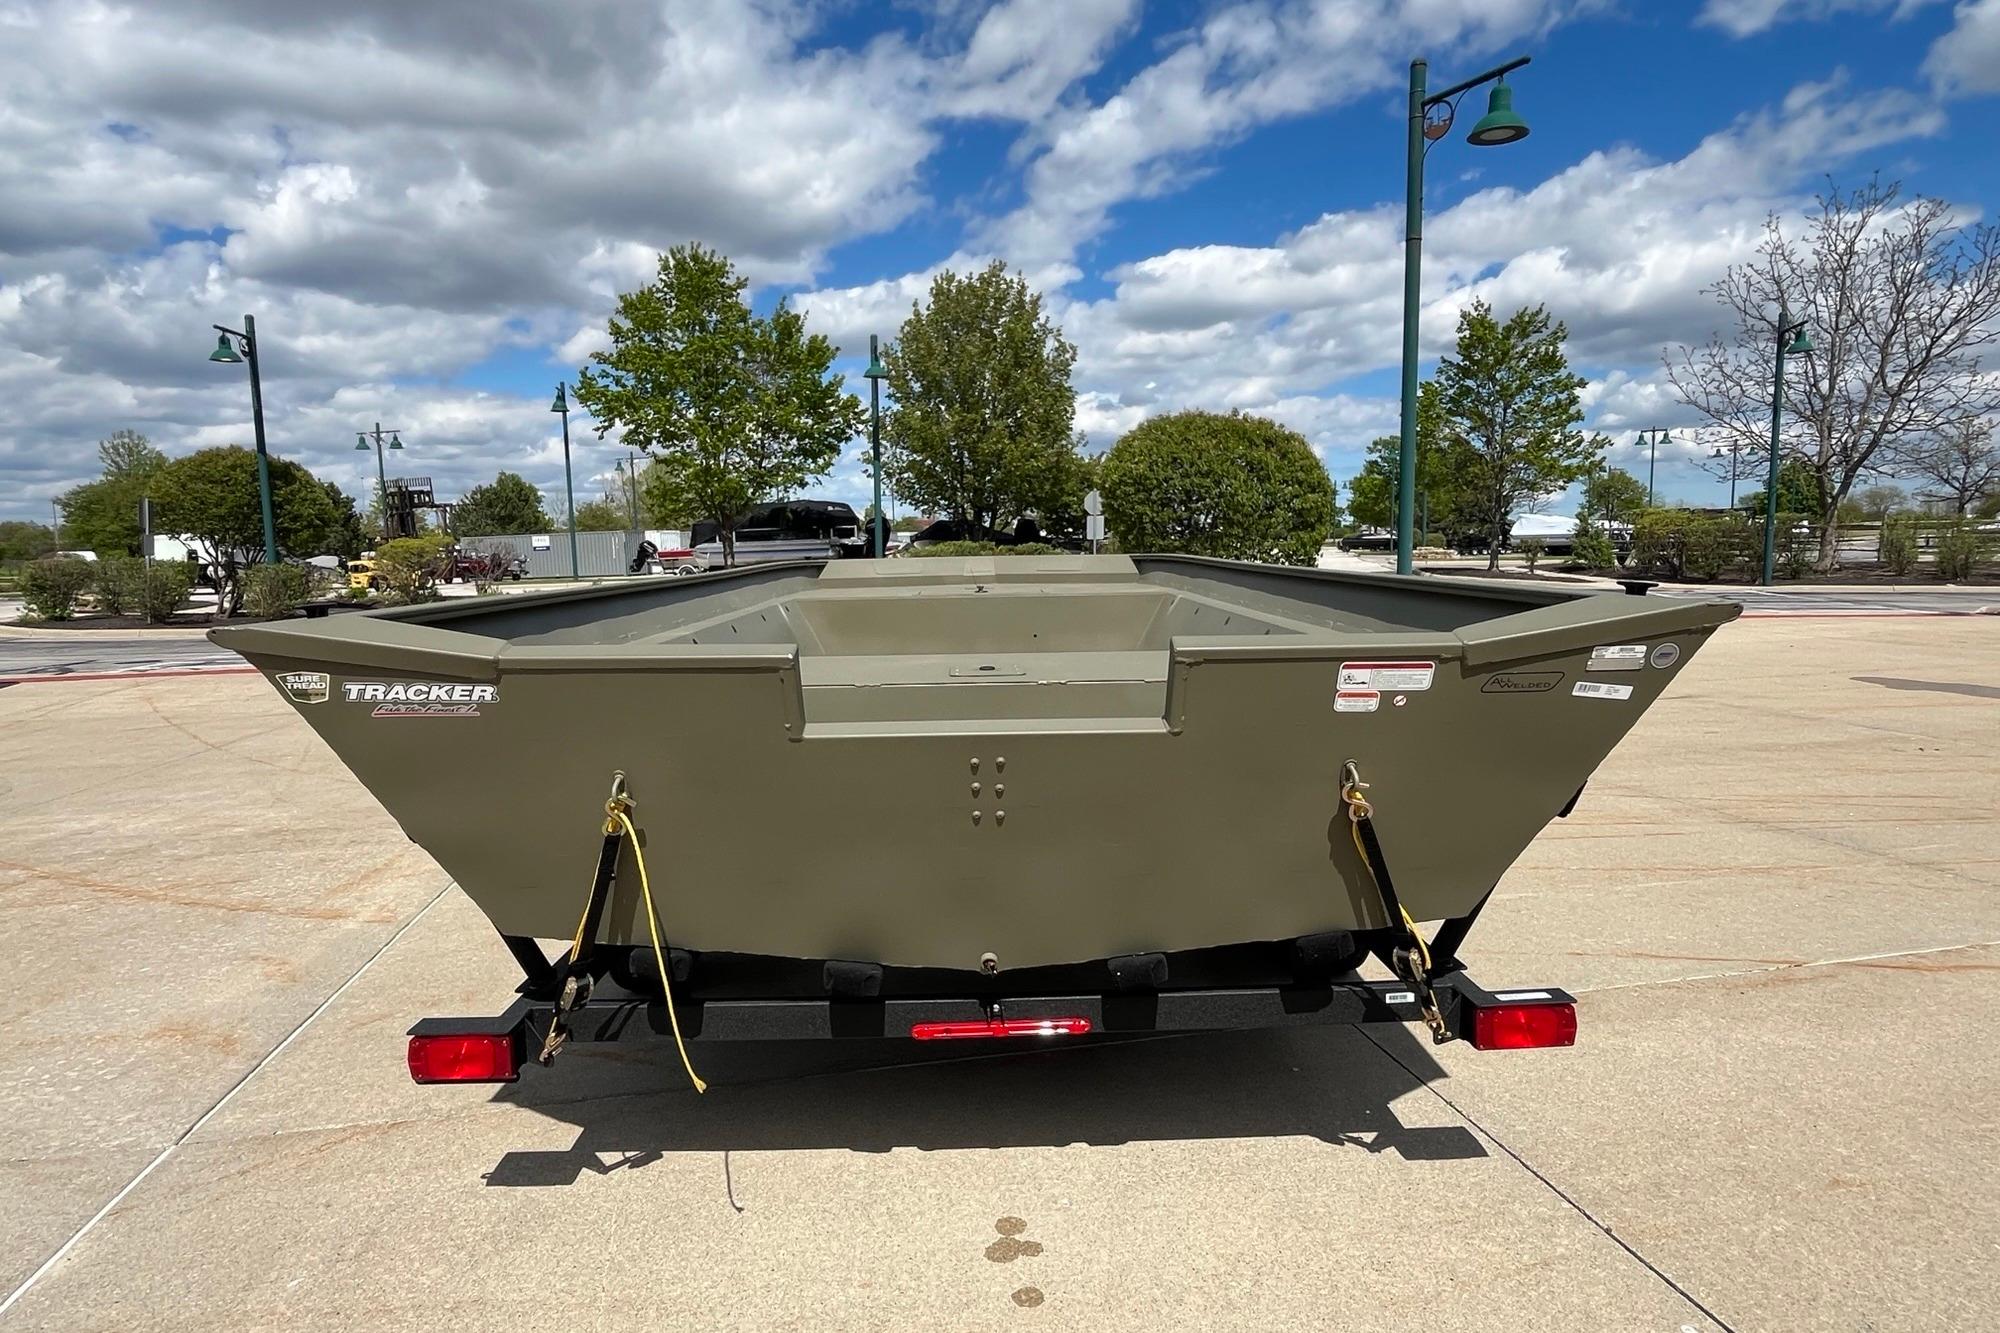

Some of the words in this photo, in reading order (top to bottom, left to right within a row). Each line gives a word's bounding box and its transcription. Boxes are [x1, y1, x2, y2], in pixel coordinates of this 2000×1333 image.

[286, 675, 321, 683] SURE
[285, 682, 326, 690] TREAD
[1498, 680, 1551, 688] WELDED
[343, 683, 496, 702] TRACKER
